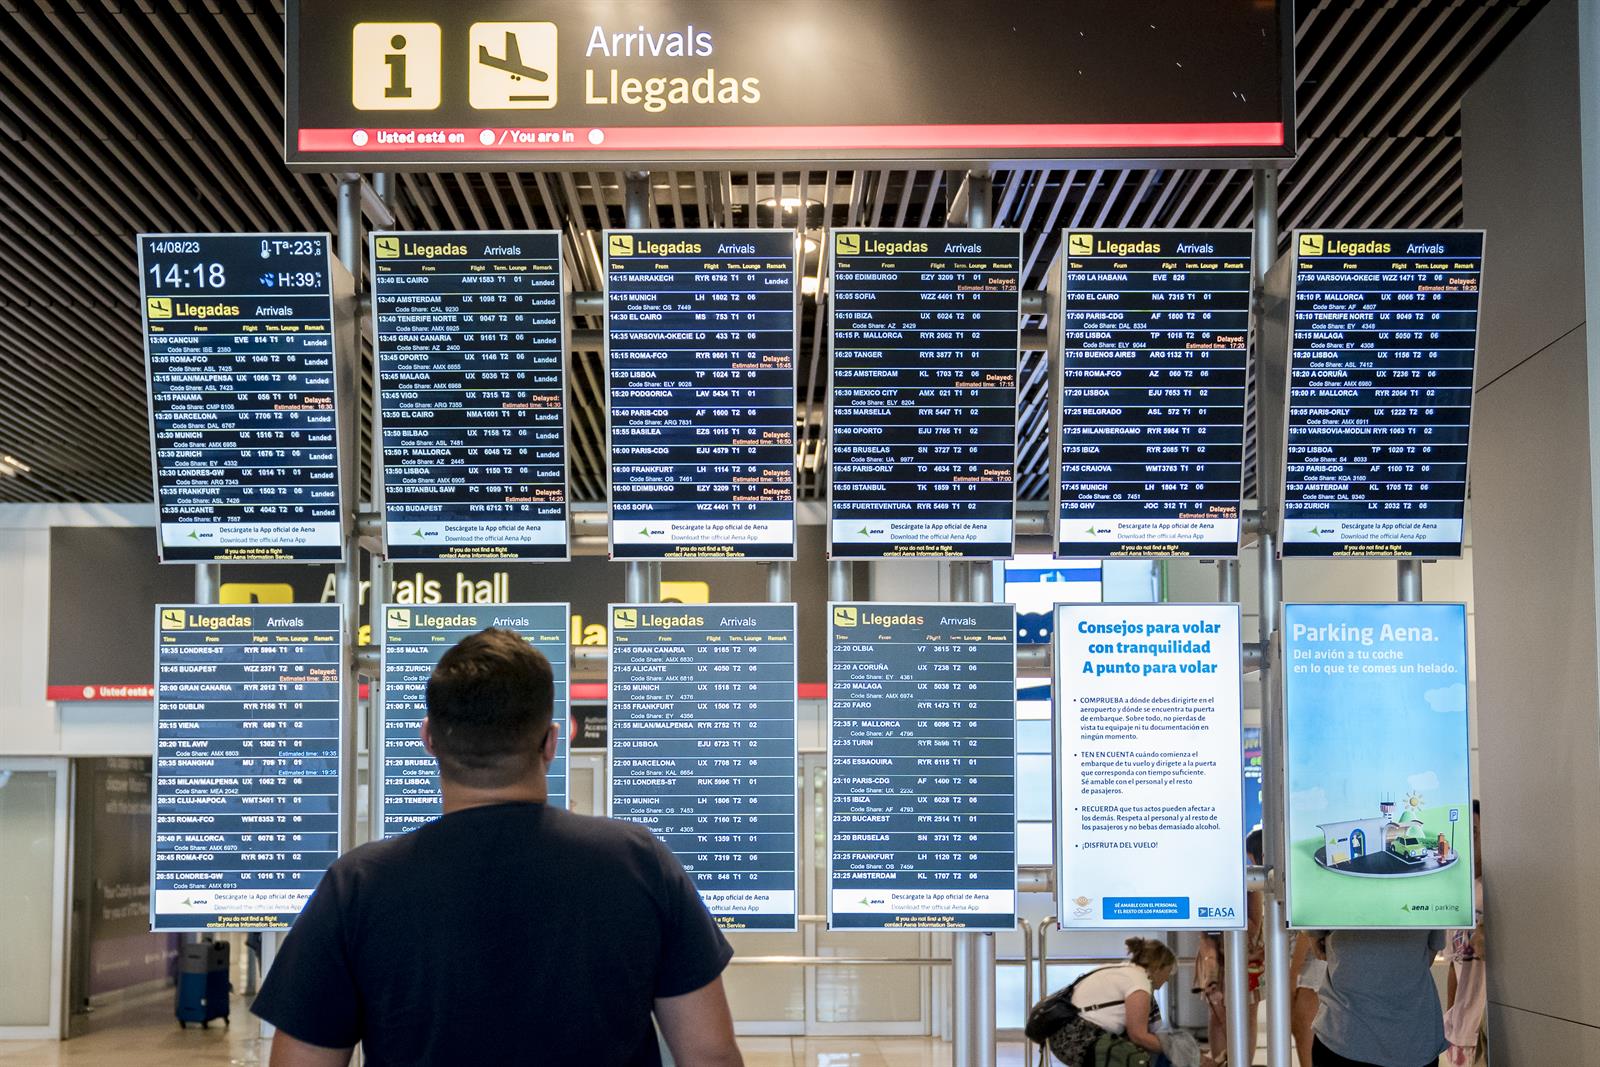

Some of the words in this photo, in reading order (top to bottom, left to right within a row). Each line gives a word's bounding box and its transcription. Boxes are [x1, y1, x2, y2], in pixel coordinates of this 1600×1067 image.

[586, 25, 713, 58] Arrivals
[586, 69, 761, 112] Llegadas
[377, 131, 414, 143] Usted
[418, 131, 445, 143] está
[449, 134, 464, 143] en
[510, 131, 535, 143] You
[538, 134, 560, 143] are
[563, 131, 574, 143] in
[150, 242, 199, 253] 14/08/23
[404, 243, 468, 258] Llegadas
[484, 246, 521, 256] Arrivals
[638, 241, 701, 256] Llegadas
[718, 244, 755, 254] Arrivals
[865, 240, 928, 255] Llegadas
[944, 243, 982, 253] Arrivals
[1097, 241, 1161, 256] Llegadas
[1177, 244, 1213, 253] Arrivals
[1327, 241, 1391, 256] Llegadas
[1407, 244, 1444, 254] Arrivals
[150, 263, 225, 288] 14:18
[176, 303, 240, 318] Llegadas
[256, 306, 293, 316] Arrivals
[456, 572, 509, 603] hall
[190, 615, 252, 629] Llegadas
[267, 617, 304, 627] Arrivals
[415, 614, 477, 628] Llegadas
[493, 617, 529, 626] Arrivals
[642, 615, 704, 629] Llegadas
[720, 617, 756, 626] Arrivals
[862, 613, 924, 627] Llegadas
[940, 616, 976, 625] Arrivals
[1078, 621, 1143, 636] Consejos
[1147, 623, 1179, 636] para
[1183, 621, 1220, 633] volar
[1293, 624, 1374, 645] Parking
[1380, 624, 1439, 641] Aena.
[1088, 643, 1113, 653] con
[1117, 640, 1210, 656] tranquilidad
[1294, 650, 1311, 659] Del
[1315, 650, 1344, 659] avión
[1358, 651, 1369, 659] tu
[1372, 650, 1403, 659] coche
[1083, 661, 1093, 673] A
[1097, 663, 1140, 676] punto
[1144, 663, 1176, 676] para
[1180, 660, 1217, 673] volar
[1311, 664, 1320, 672] lo
[1324, 666, 1344, 675] que
[1348, 664, 1359, 672] te
[1418, 664, 1457, 672] helado.
[1082, 842, 1118, 850] ¡DISFRUTA
[1208, 908, 1235, 917] EASA
[1435, 904, 1459, 912] parking
